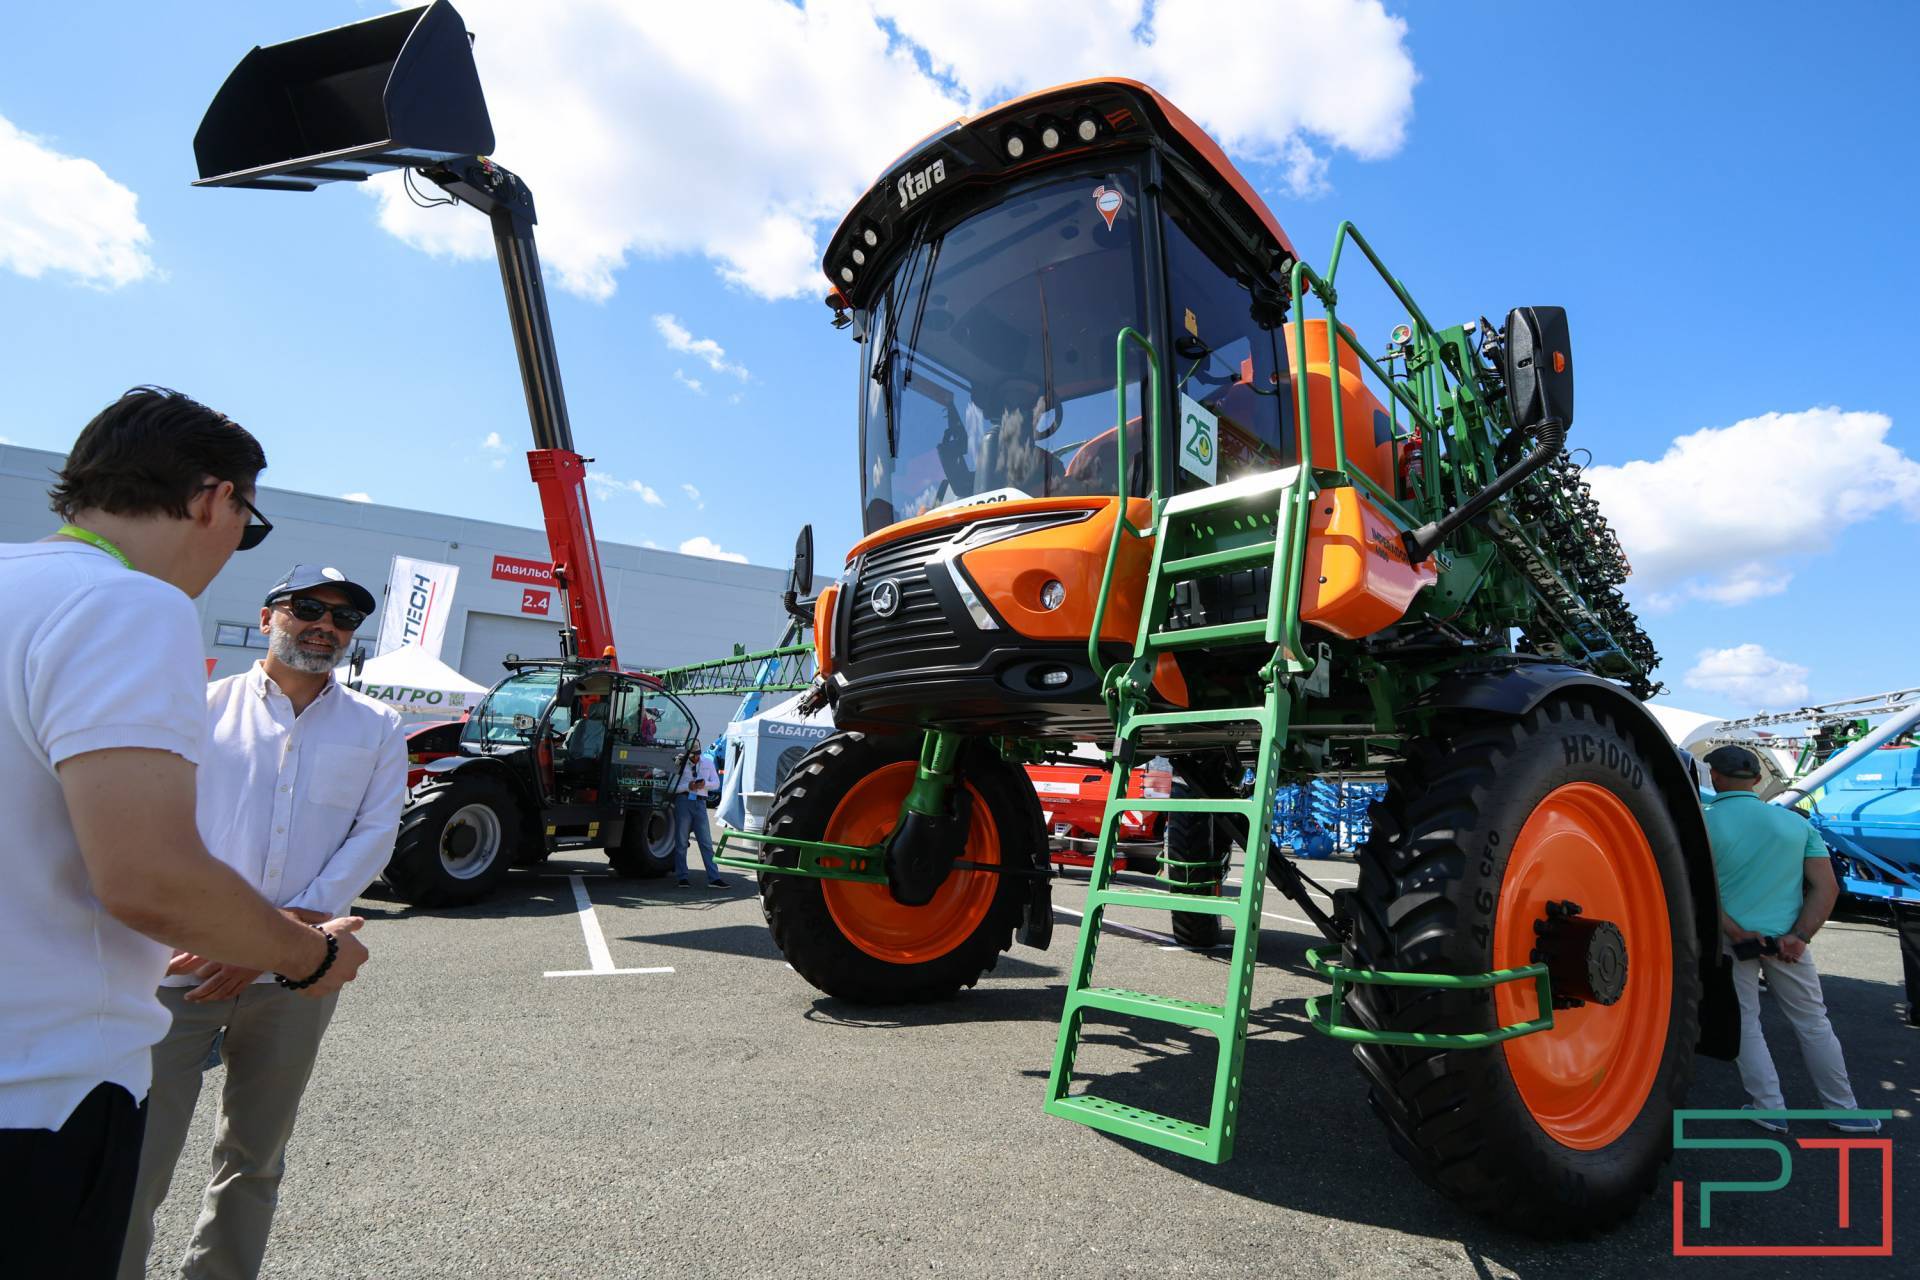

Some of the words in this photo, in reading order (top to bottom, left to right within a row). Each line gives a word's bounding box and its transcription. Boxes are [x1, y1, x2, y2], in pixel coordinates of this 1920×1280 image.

[898, 158, 946, 209] Stara
[495, 563, 552, 579] ПАВИЛЬО
[523, 595, 548, 609] 2.4
[365, 684, 443, 704] БАГРО
[768, 724, 827, 738] САБАГРО
